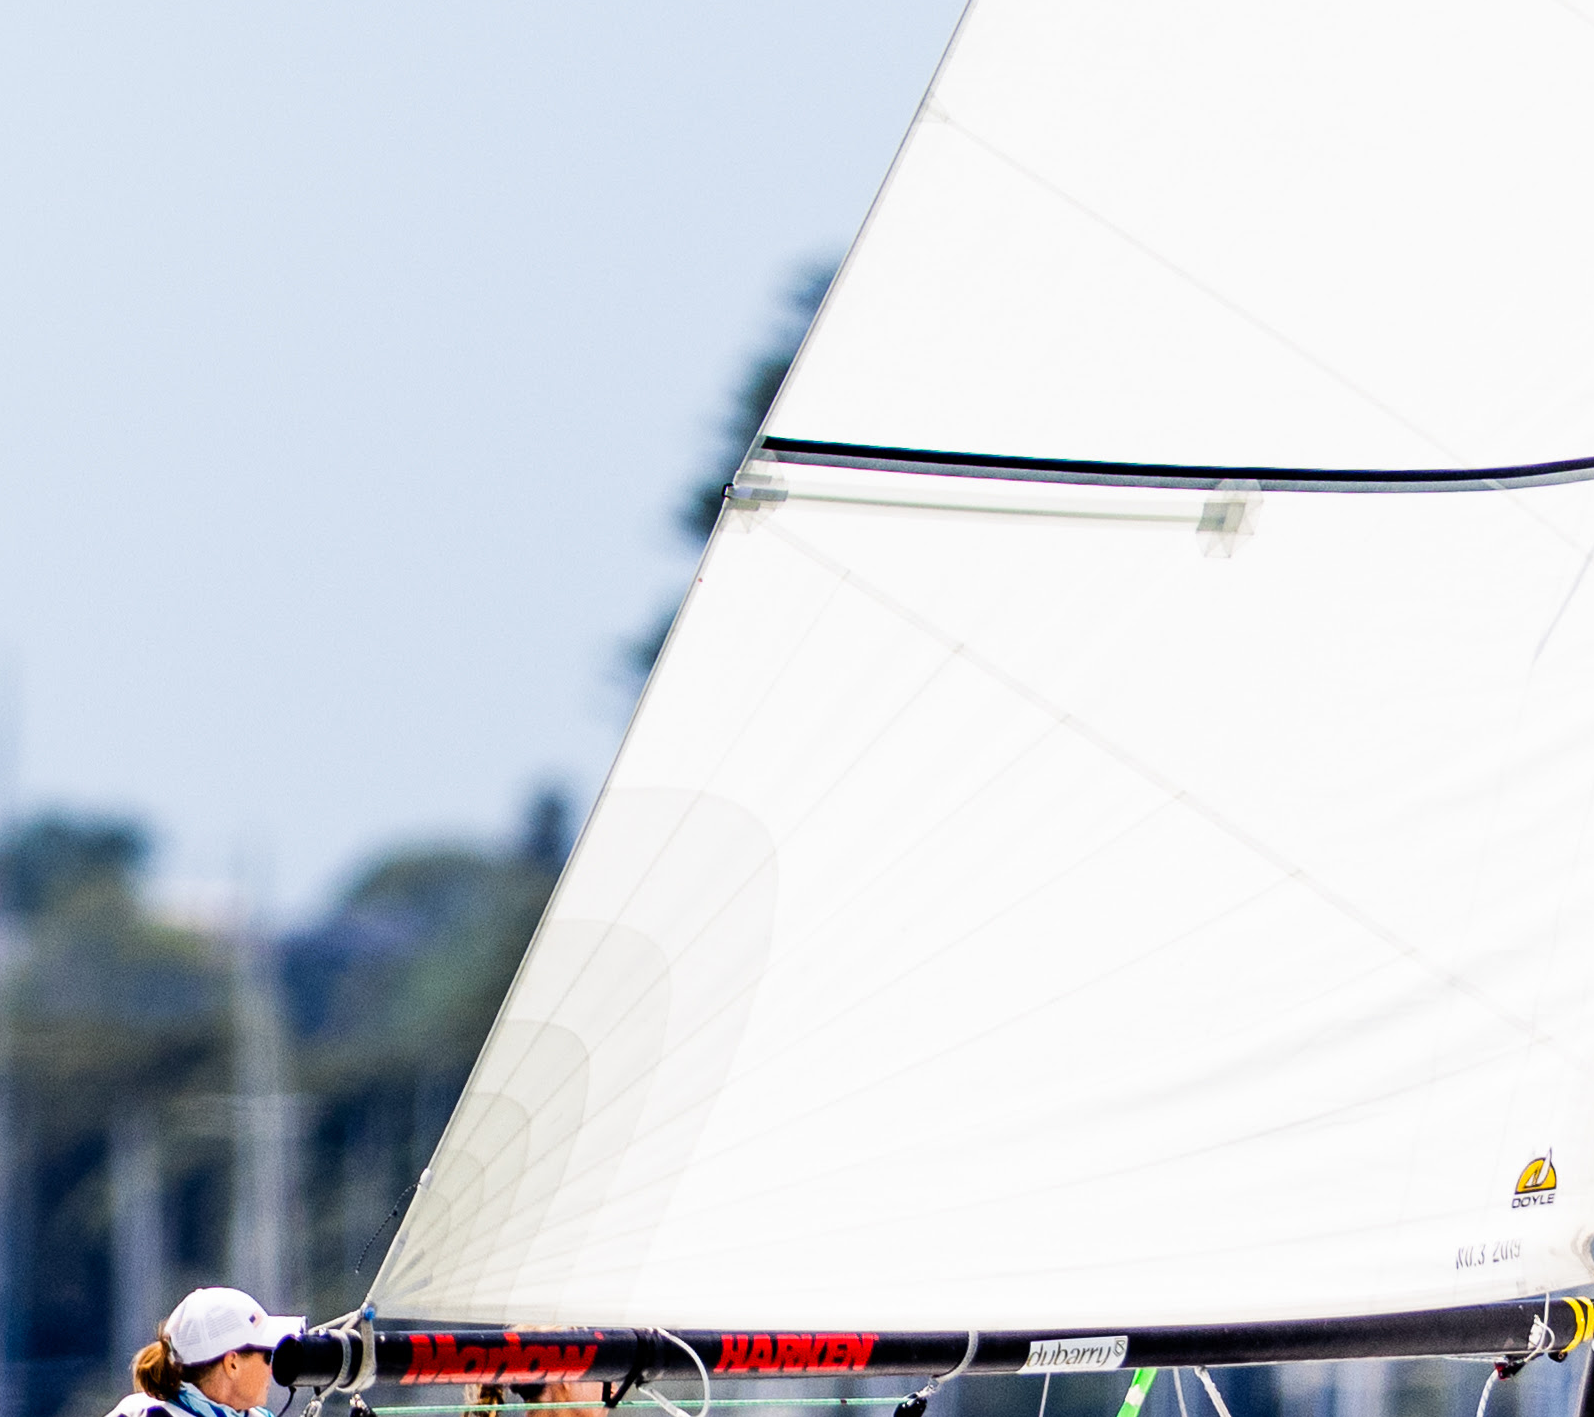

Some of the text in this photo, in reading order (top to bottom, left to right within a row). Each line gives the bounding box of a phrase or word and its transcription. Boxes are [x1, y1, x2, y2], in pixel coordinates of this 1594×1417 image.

[1511, 1193, 1555, 1209] DOYLE
[713, 1333, 874, 1373] HARKEN
[1026, 1342, 1111, 1367] dubarry
